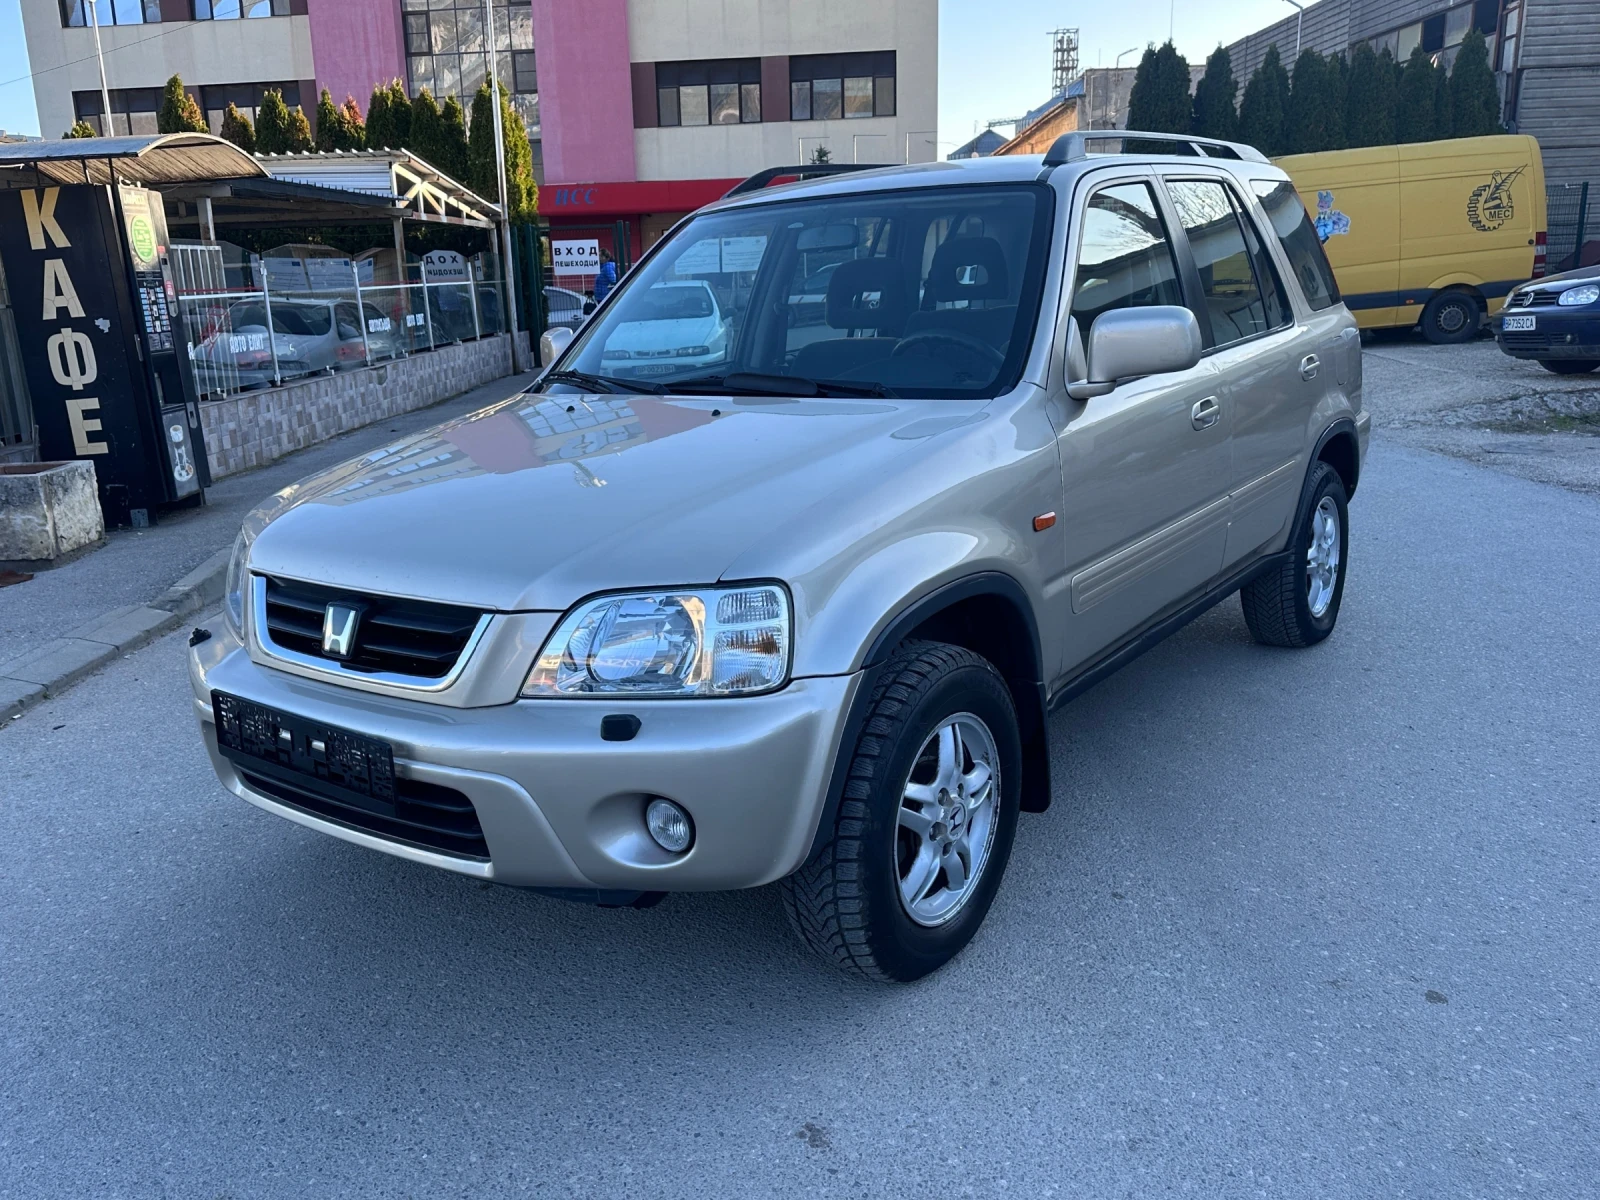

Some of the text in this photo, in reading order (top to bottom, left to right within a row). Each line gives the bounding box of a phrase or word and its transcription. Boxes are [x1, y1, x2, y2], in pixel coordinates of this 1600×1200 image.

[554, 246, 598, 257] ВХОД
[555, 260, 599, 268] ПЕШЕХОДЦИ
[20, 187, 109, 456] КАФЕ
